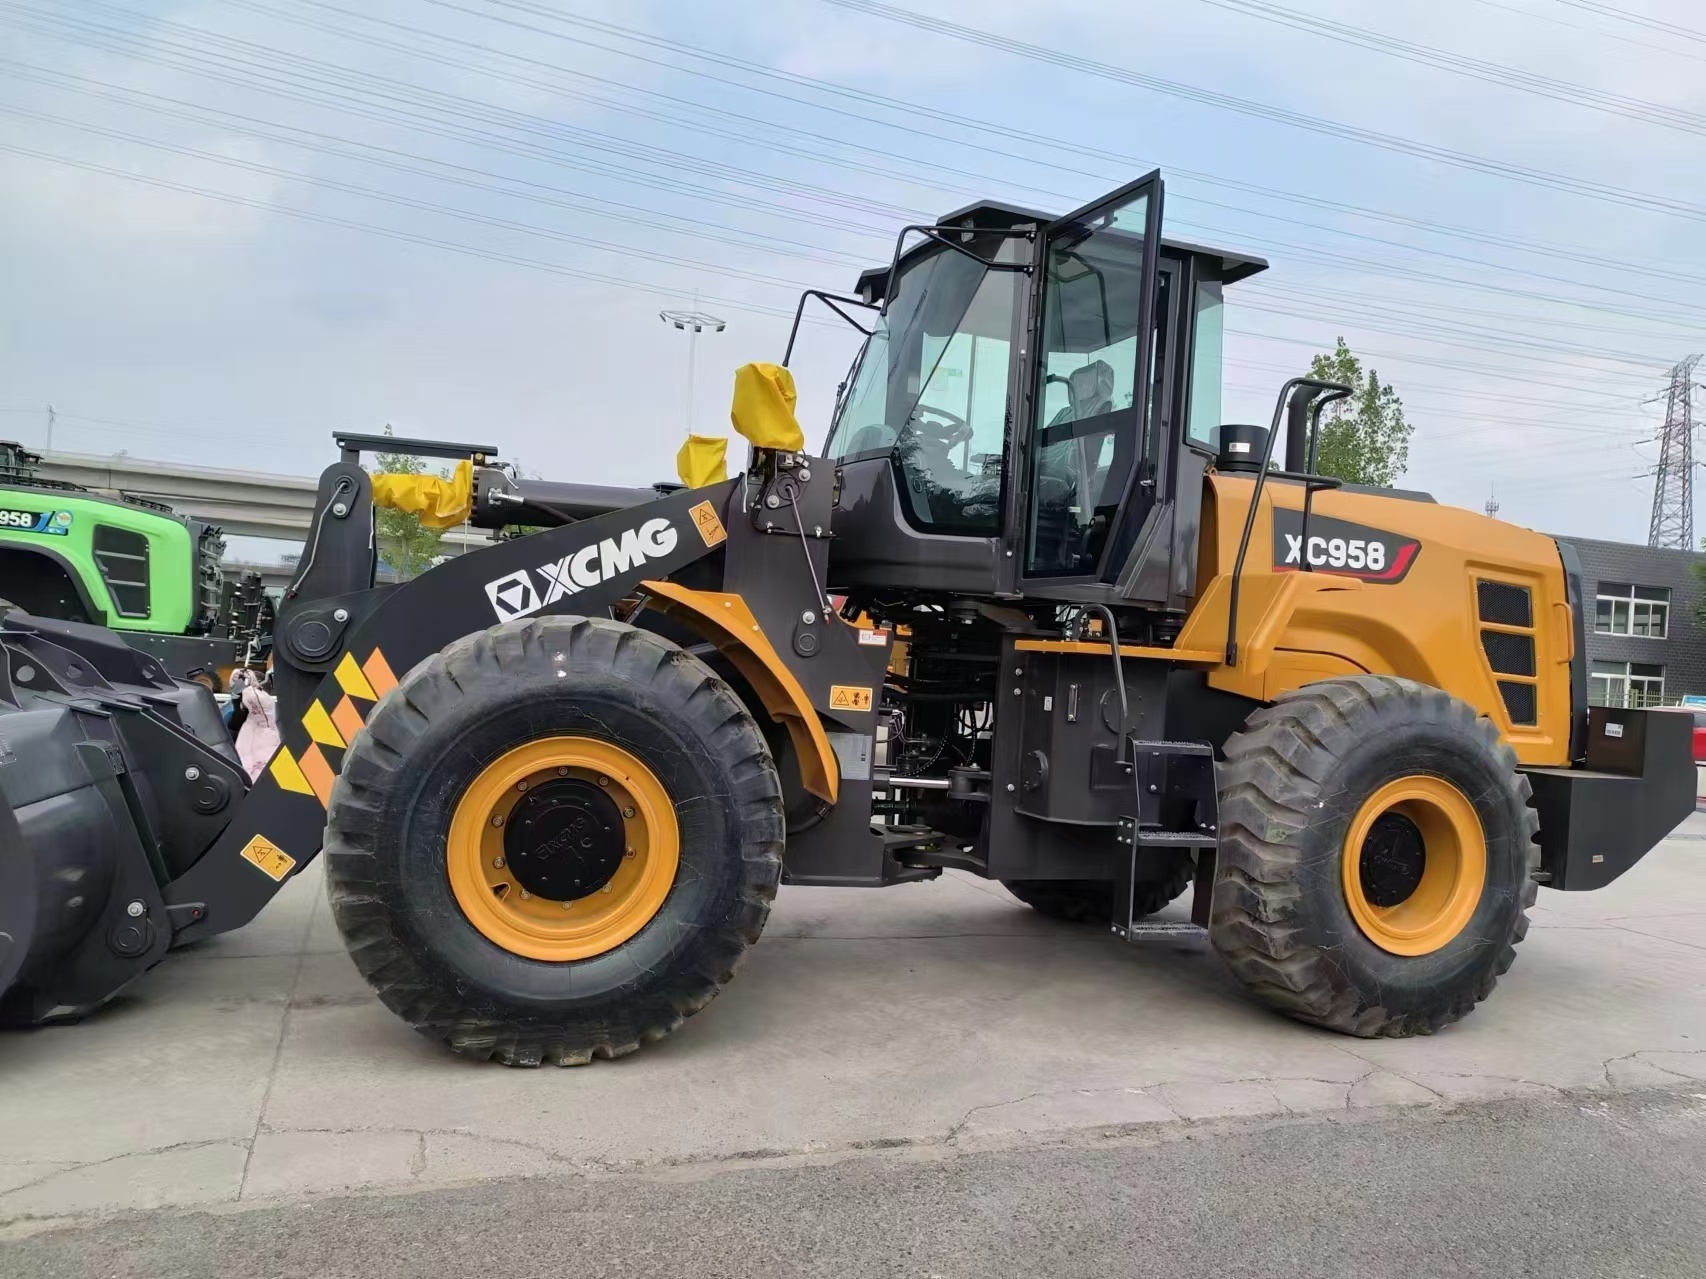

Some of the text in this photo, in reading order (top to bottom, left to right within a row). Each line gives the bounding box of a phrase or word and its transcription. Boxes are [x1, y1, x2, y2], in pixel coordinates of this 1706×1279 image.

[0, 510, 32, 528] 958
[536, 517, 678, 607] XCMG
[1284, 533, 1385, 571] XC958
